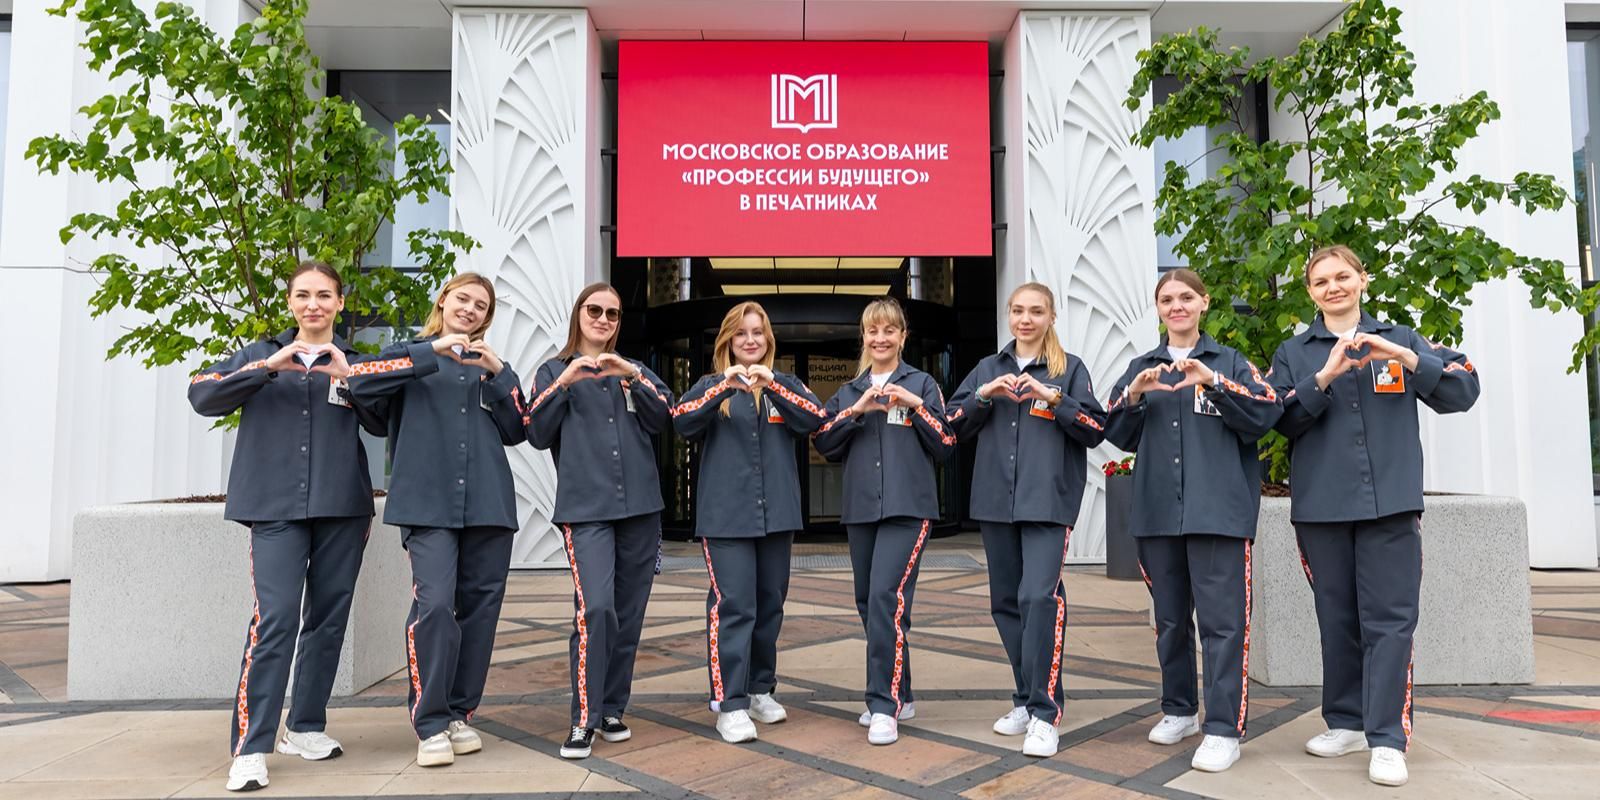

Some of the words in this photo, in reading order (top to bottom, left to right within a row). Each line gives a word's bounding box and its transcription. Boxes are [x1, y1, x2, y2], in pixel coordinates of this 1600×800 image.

[663, 144, 801, 160] МОСКОВСКОЕ
[807, 144, 948, 160] ОБРАЗОВАНИЕ
[682, 168, 812, 185] «ПРОФЕССИИ
[819, 169, 929, 187] БУДУЩЕГО»
[740, 194, 750, 210] В
[756, 194, 877, 210] ПЕЧАТНИКАХ
[790, 364, 847, 372] ПЕНЦИАЛ
